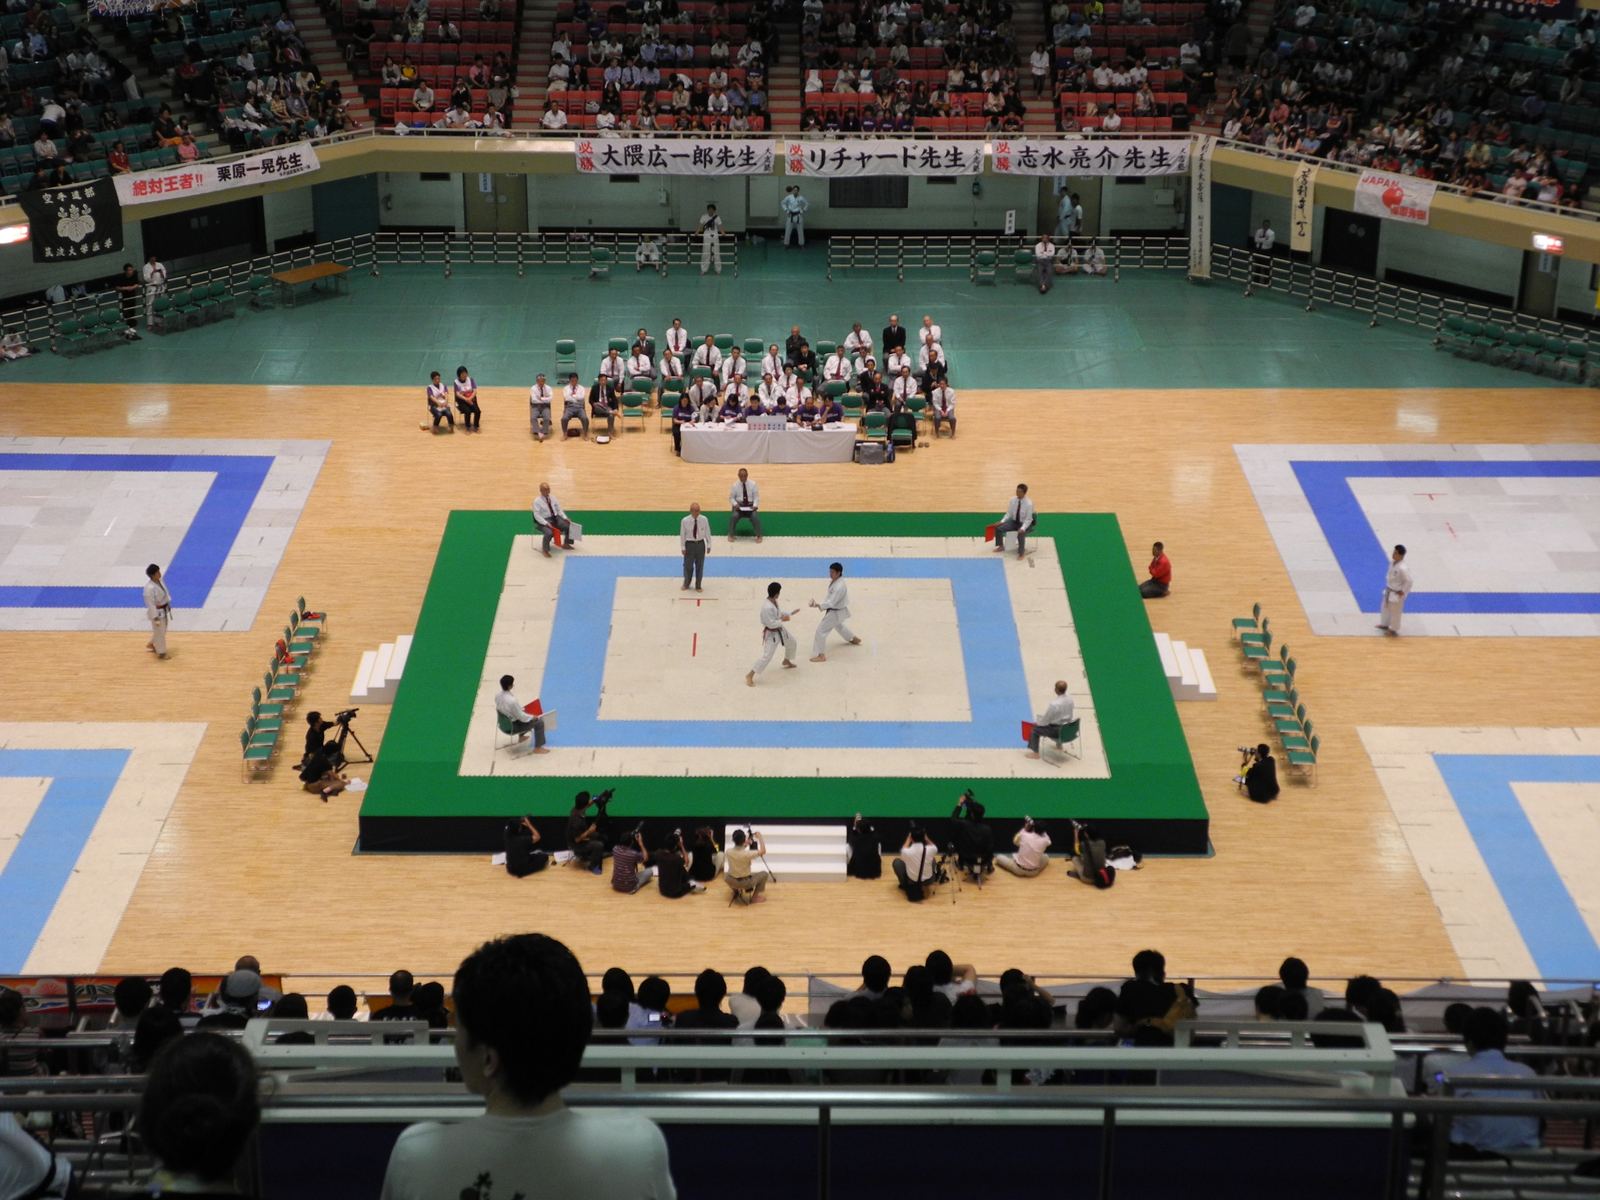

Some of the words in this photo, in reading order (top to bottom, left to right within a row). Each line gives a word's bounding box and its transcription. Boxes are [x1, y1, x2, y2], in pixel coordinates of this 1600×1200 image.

[601, 144, 757, 168] 大隈広一郎先生
[810, 145, 966, 171] リチャード先生
[1017, 145, 1172, 170] 志水亮介先生
